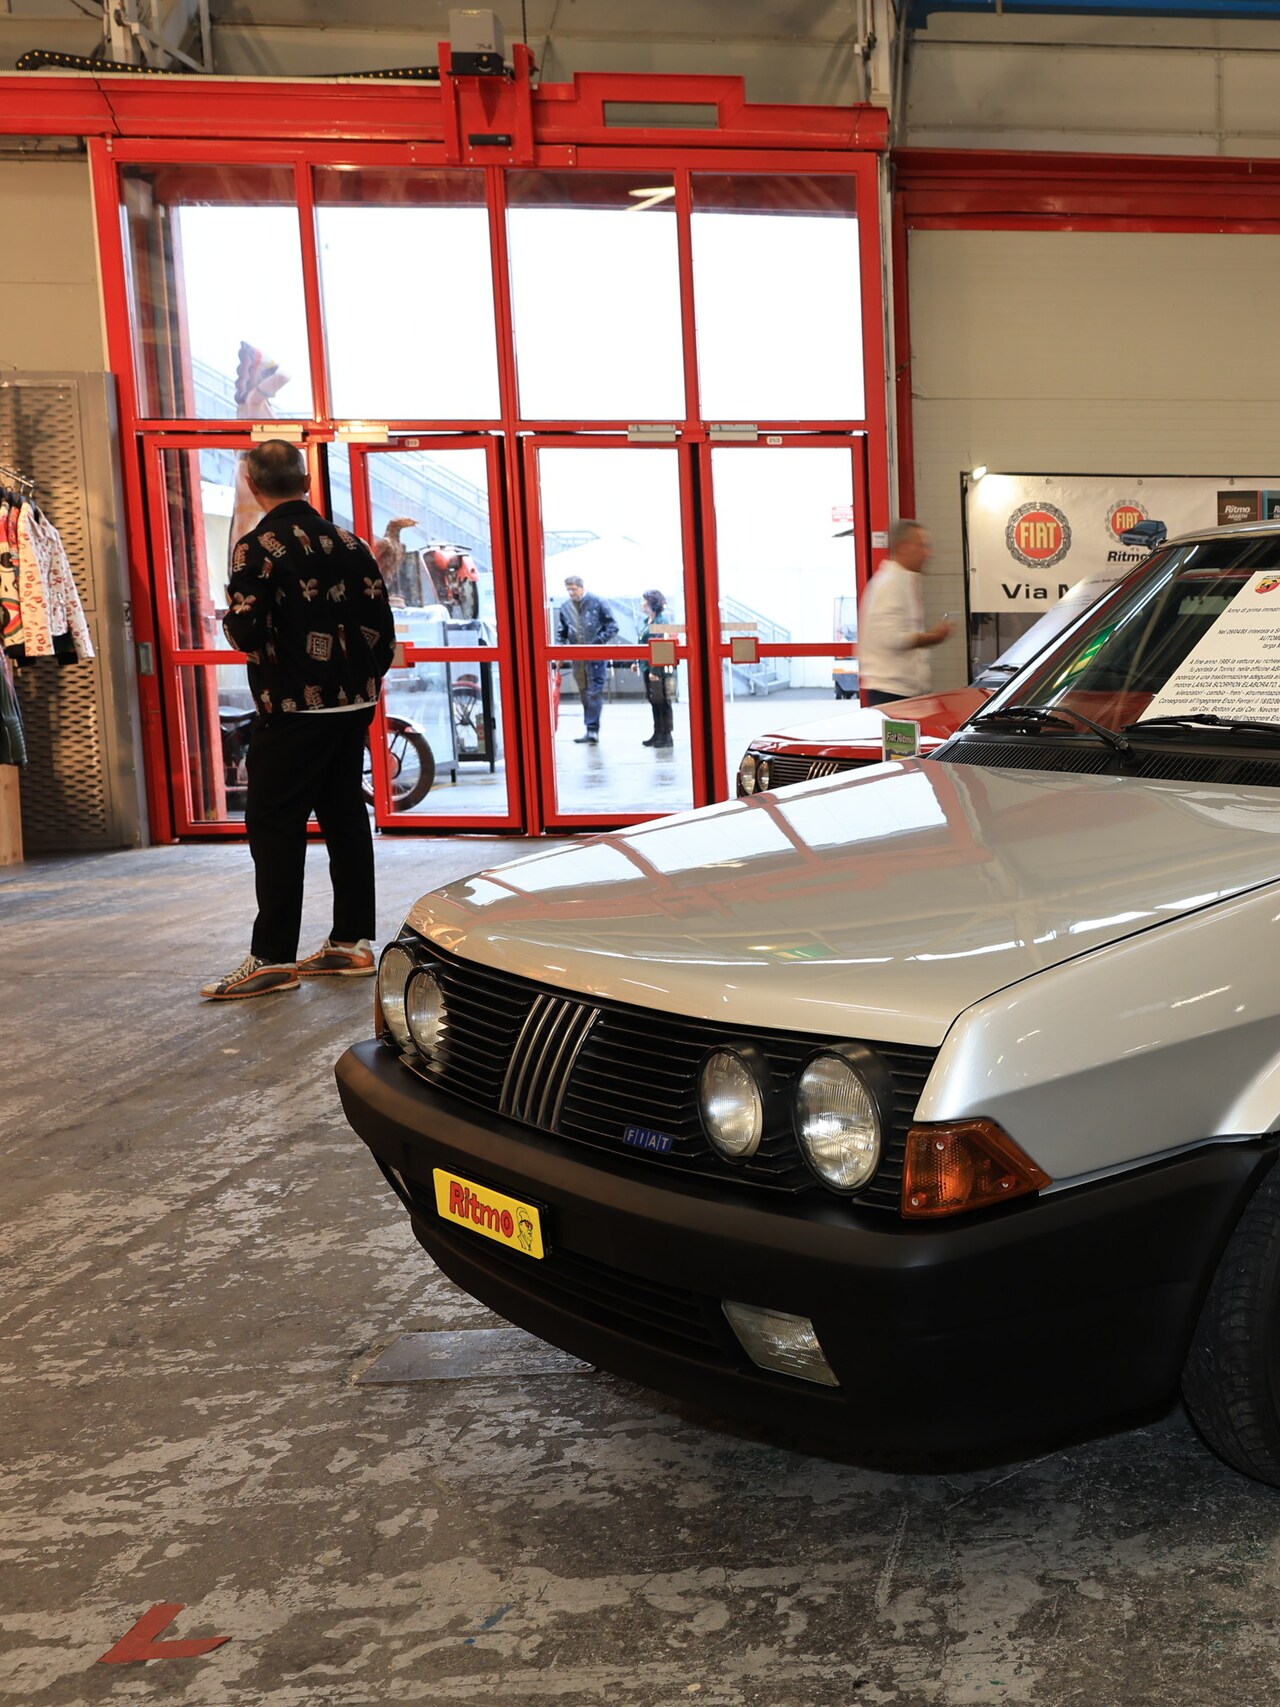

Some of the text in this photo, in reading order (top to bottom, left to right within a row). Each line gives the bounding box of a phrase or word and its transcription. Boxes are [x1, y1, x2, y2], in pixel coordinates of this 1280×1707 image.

[1224, 505, 1251, 513] Ritmo
[1115, 512, 1140, 529] FIAT
[1020, 522, 1057, 549] FIAT
[1002, 584, 1048, 599] Via
[1159, 697, 1189, 705] Consegnata
[887, 731, 915, 745] Fiat Ritmo
[627, 1128, 671, 1151] FIAT
[449, 1180, 514, 1239] Ritmo
